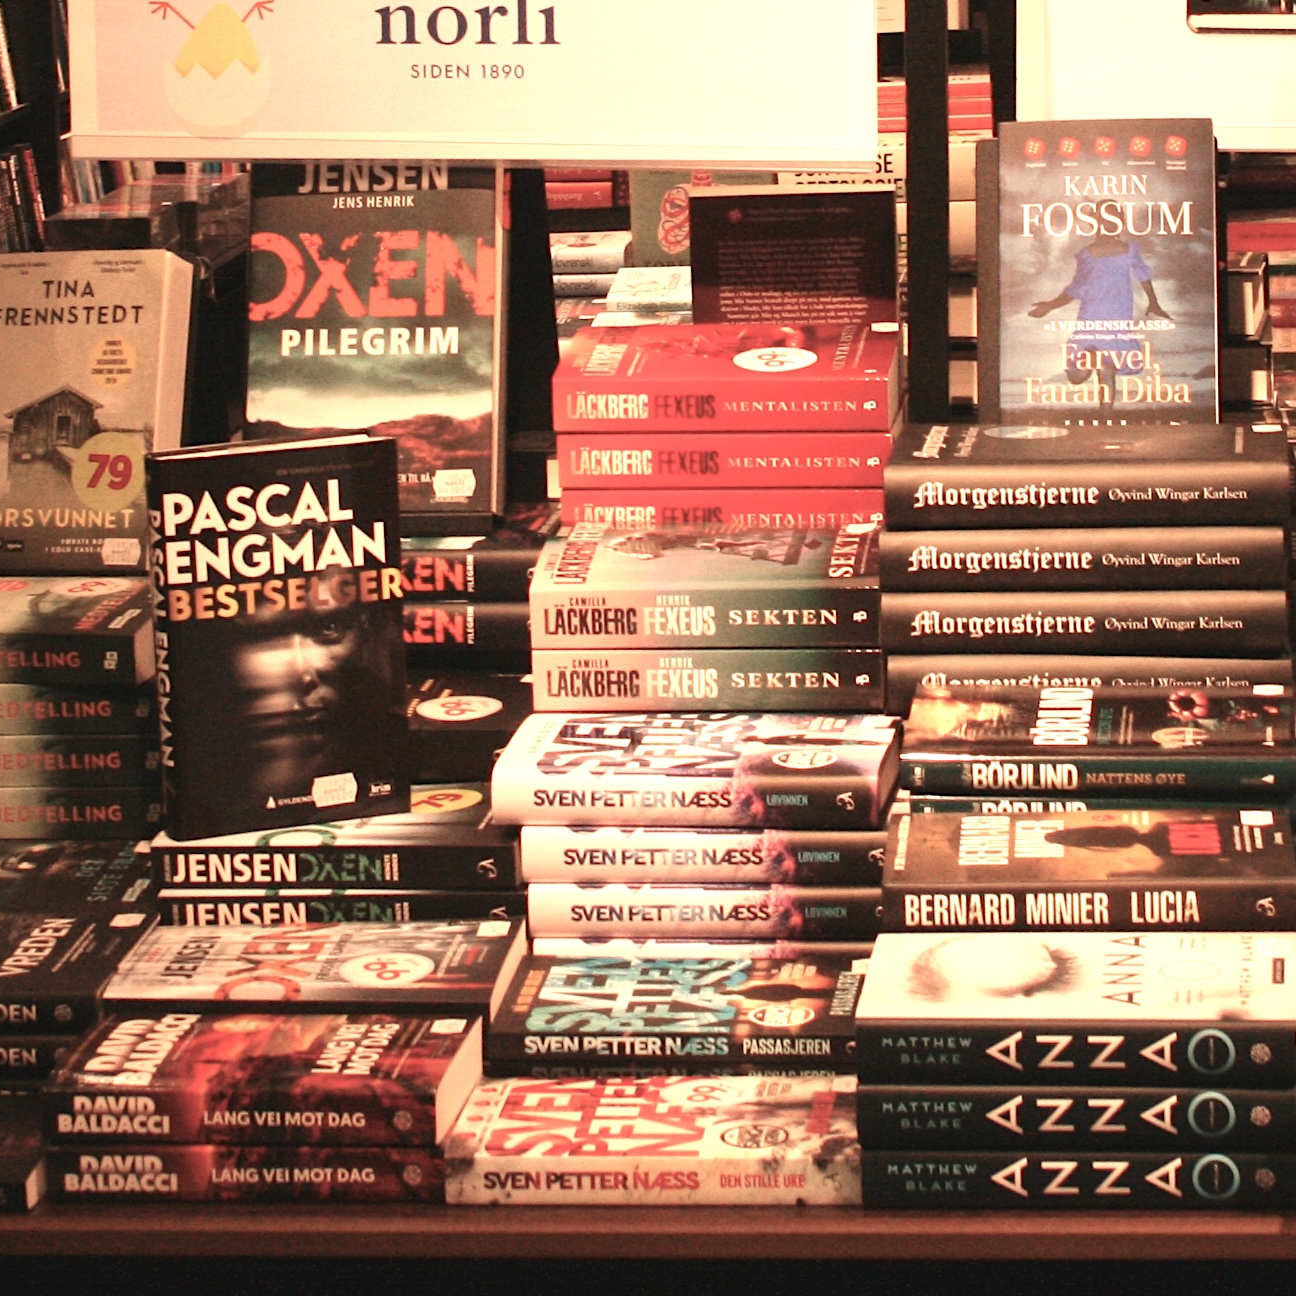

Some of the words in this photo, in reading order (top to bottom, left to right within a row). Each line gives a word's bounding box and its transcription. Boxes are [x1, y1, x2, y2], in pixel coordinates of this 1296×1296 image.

[410, 63, 470, 79] SIDEN
[481, 64, 525, 79] 1890
[1064, 175, 1147, 196] KARIN
[333, 197, 363, 209] JENS
[366, 195, 415, 208] HENRIK
[1021, 201, 1194, 238] FOSSUM
[42, 279, 94, 299] TINA
[281, 327, 460, 357] PILEGRIM
[1060, 341, 1161, 371] Farvel,
[1025, 377, 1111, 405] Farah
[1120, 375, 1191, 404] Diba
[567, 391, 648, 420] LÄCKBERG
[654, 395, 715, 419] FEXEUS
[723, 400, 857, 412] MENTALISTEN
[86, 454, 133, 490] 79
[163, 479, 354, 537] PASCAL
[914, 482, 1099, 510] Morgenstjerne
[1109, 486, 1153, 502] Øyvind
[1155, 486, 1201, 502] Wingar
[1202, 486, 1248, 500] Karlsen
[166, 523, 386, 585] ENGMAN
[169, 568, 404, 621] BESTSELGER
[728, 609, 838, 627] SEKTEN
[972, 761, 1078, 791] BÖRJLIND
[1086, 772, 1153, 785] NATTENS
[1155, 772, 1186, 785] ØYE
[173, 853, 297, 884] JENSEN
[904, 893, 1015, 926] BERNARD
[1026, 892, 1109, 925] MINIER
[1131, 890, 1200, 924] LUCIA
[524, 1036, 579, 1055] SVEN
[583, 1036, 662, 1055] PETTER
[664, 1036, 729, 1055] NÆSS
[742, 1037, 831, 1056] PASSASJEREN
[79, 1155, 164, 1173] DAVID
[211, 1168, 260, 1184] LANG
[263, 1168, 290, 1184] VEI
[293, 1168, 328, 1184] MOT
[331, 1168, 376, 1184] DAG
[64, 1173, 179, 1193] BALDACCI
